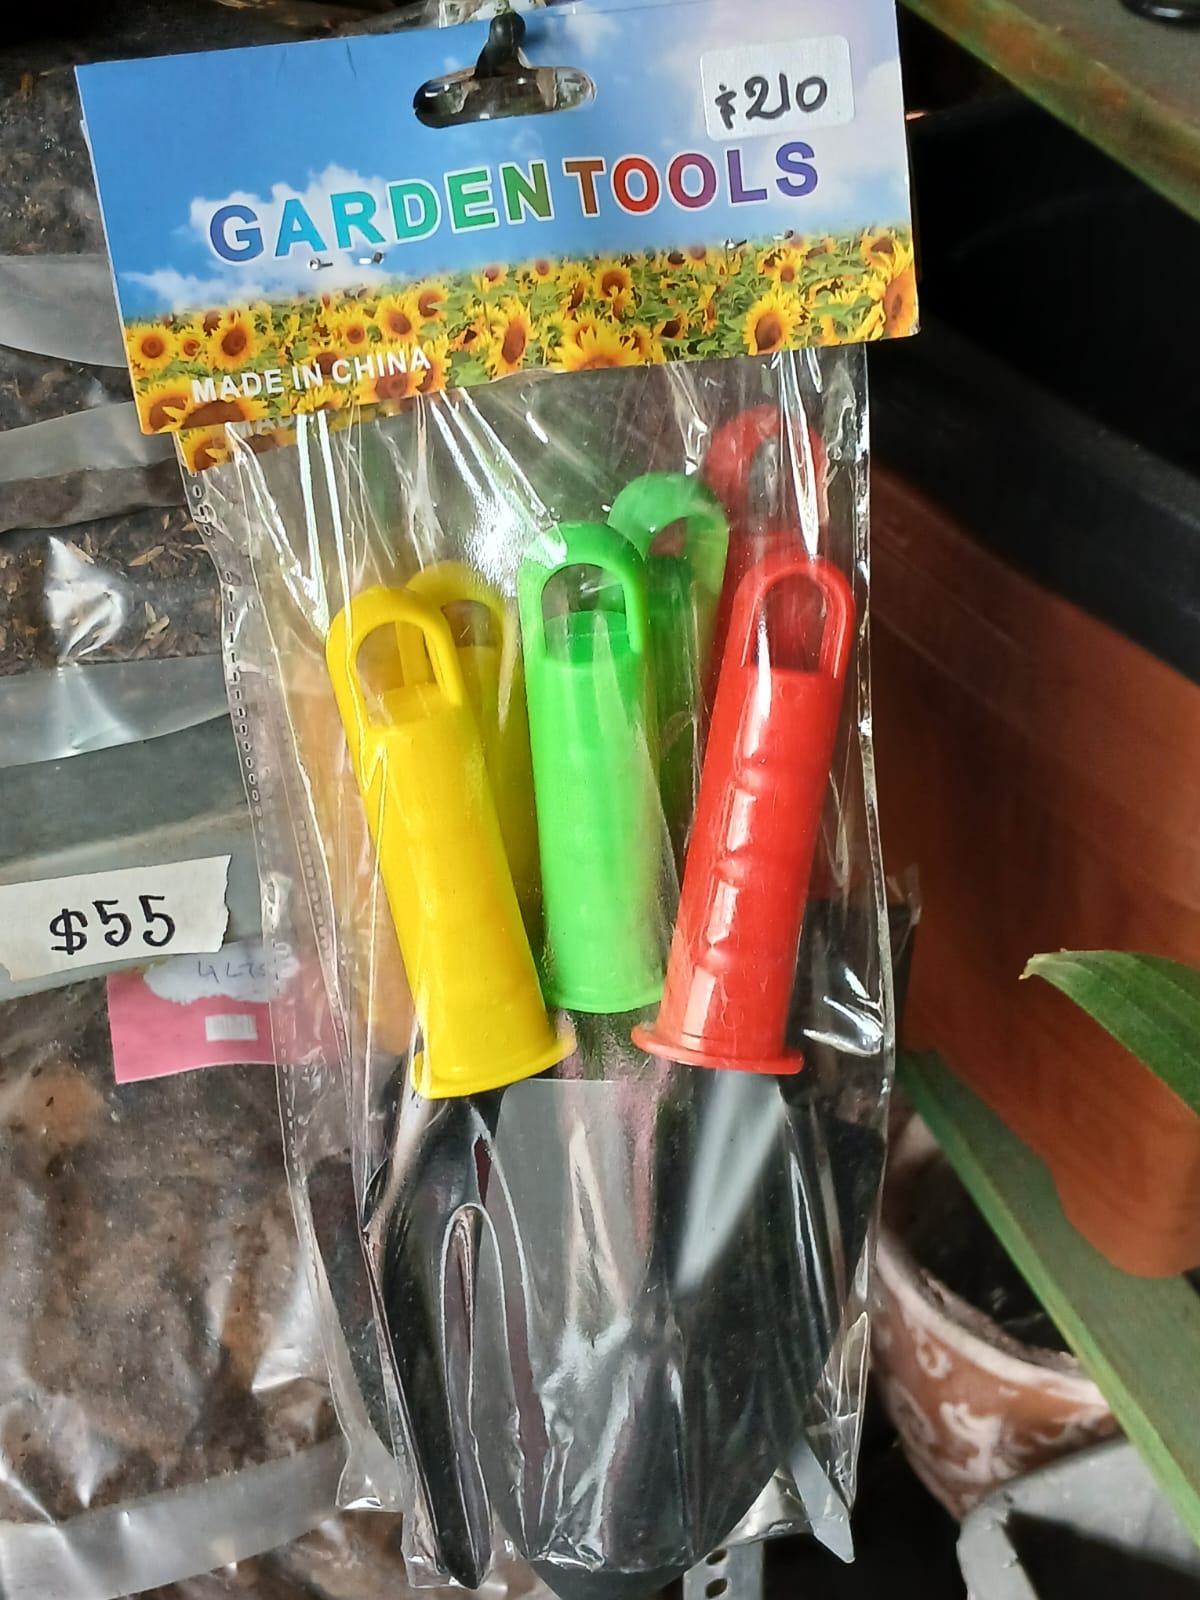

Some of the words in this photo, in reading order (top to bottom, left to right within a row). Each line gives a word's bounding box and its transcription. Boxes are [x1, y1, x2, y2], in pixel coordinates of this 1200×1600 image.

[208, 164, 552, 263] GARDEN
[564, 141, 819, 216] TOOLS
[191, 368, 285, 403] MADE
[292, 362, 324, 390] IN
[331, 346, 432, 384] CHINA
[49, 894, 176, 955] $55
